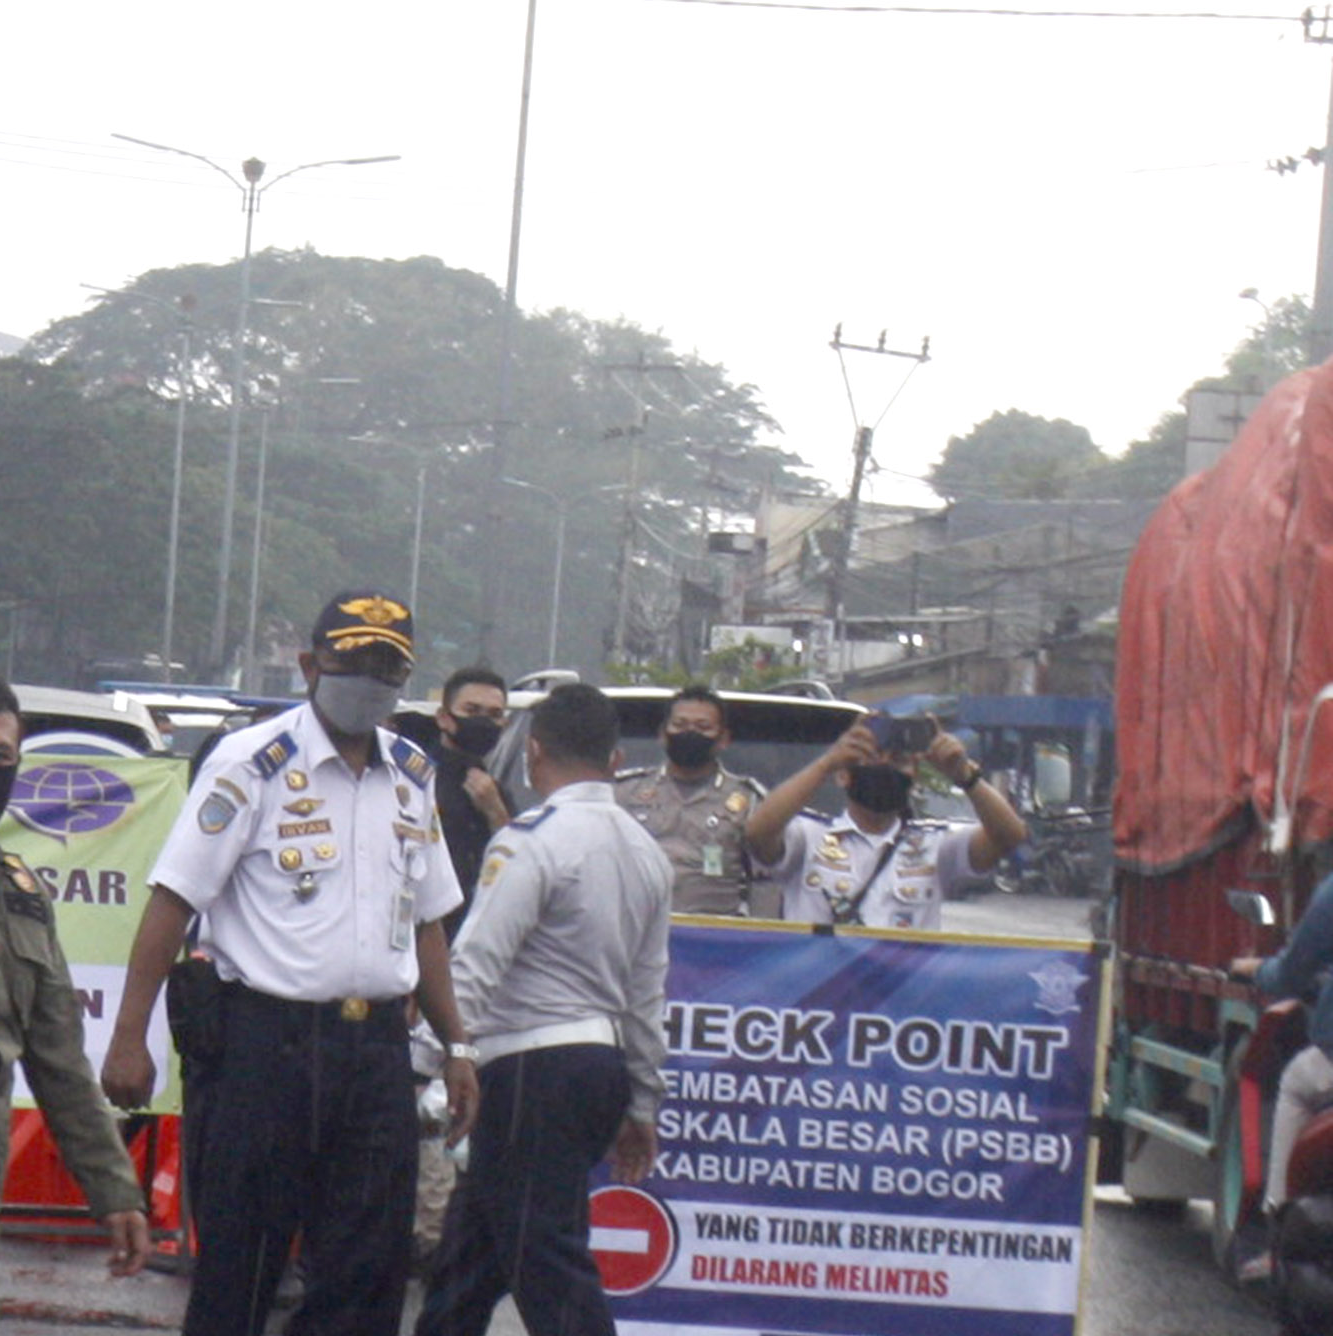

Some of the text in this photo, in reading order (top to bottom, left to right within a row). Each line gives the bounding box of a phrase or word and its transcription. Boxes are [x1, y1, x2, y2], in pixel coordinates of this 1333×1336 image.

[847, 1013, 1069, 1081] POINT
[899, 1084, 1039, 1123] SOSIAL
[657, 1108, 1073, 1173] SKALA BESAR (PSBB)
[648, 1150, 1005, 1201] KABUPATEN BOGOR
[694, 1212, 1073, 1264] YANG TIDAK BERKEPENTINGAN
[691, 1254, 949, 1298] DILARANG MELINTAS
